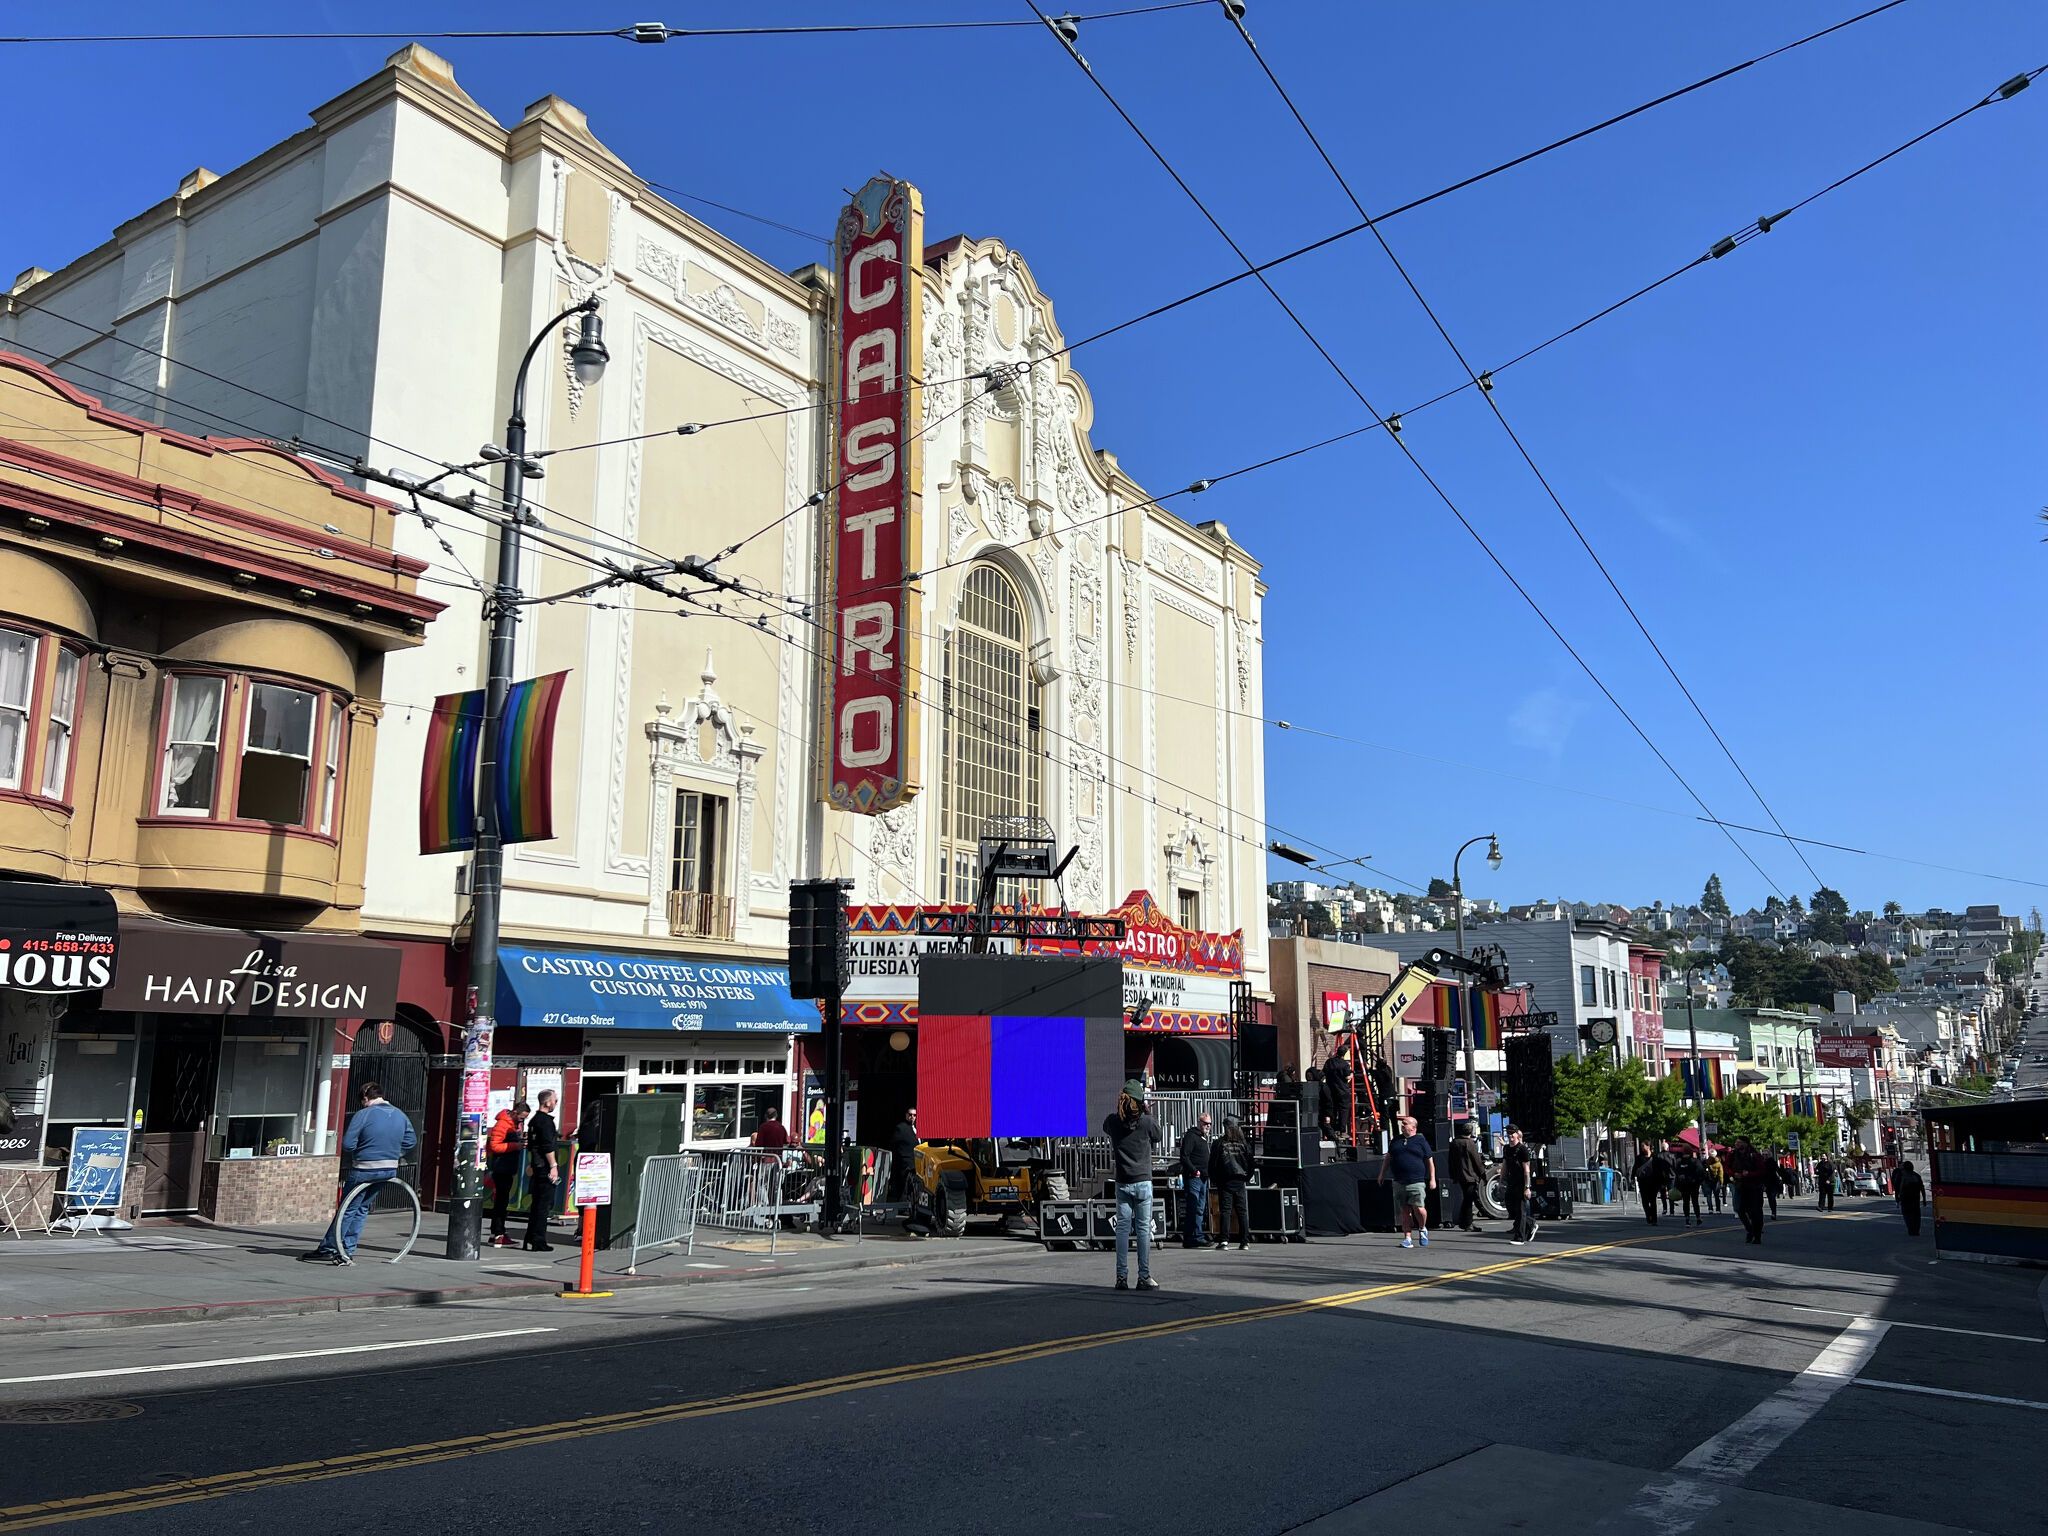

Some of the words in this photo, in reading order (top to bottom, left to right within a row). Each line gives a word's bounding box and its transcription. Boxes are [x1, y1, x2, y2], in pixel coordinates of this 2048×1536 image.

[839, 237, 897, 768] CASTRO
[56, 932, 76, 941] Free
[78, 933, 112, 944] Delivery
[22, 940, 115, 954] 415-658-7433
[909, 941, 919, 957] A
[927, 941, 1007, 954] MEMOAL
[229, 949, 298, 978] Lisa
[847, 959, 920, 975] TUESDAY
[521, 956, 614, 978] CASTRO
[618, 962, 698, 983] COFFEE
[699, 965, 788, 987] COMPANY
[590, 979, 667, 998] CUSTOM
[673, 984, 756, 1001] ROASTERS
[1150, 975, 1186, 991] MEMORIAL
[144, 974, 236, 1006] HAIR
[251, 980, 368, 1010] DESIGN
[1152, 992, 1168, 1006] MAY
[1171, 993, 1180, 1007] 23
[660, 999, 687, 1009] Since
[687, 1000, 707, 1010] 1970
[1389, 992, 1408, 1020] JLG
[542, 1013, 559, 1024] 427
[560, 1013, 589, 1025] Castro
[590, 1015, 615, 1026] Street
[735, 1020, 808, 1030] www.castro-coffee.com
[1158, 1073, 1195, 1083] NAILS
[279, 1144, 299, 1156] OPEN
[1060, 1216, 1068, 1228] 4
